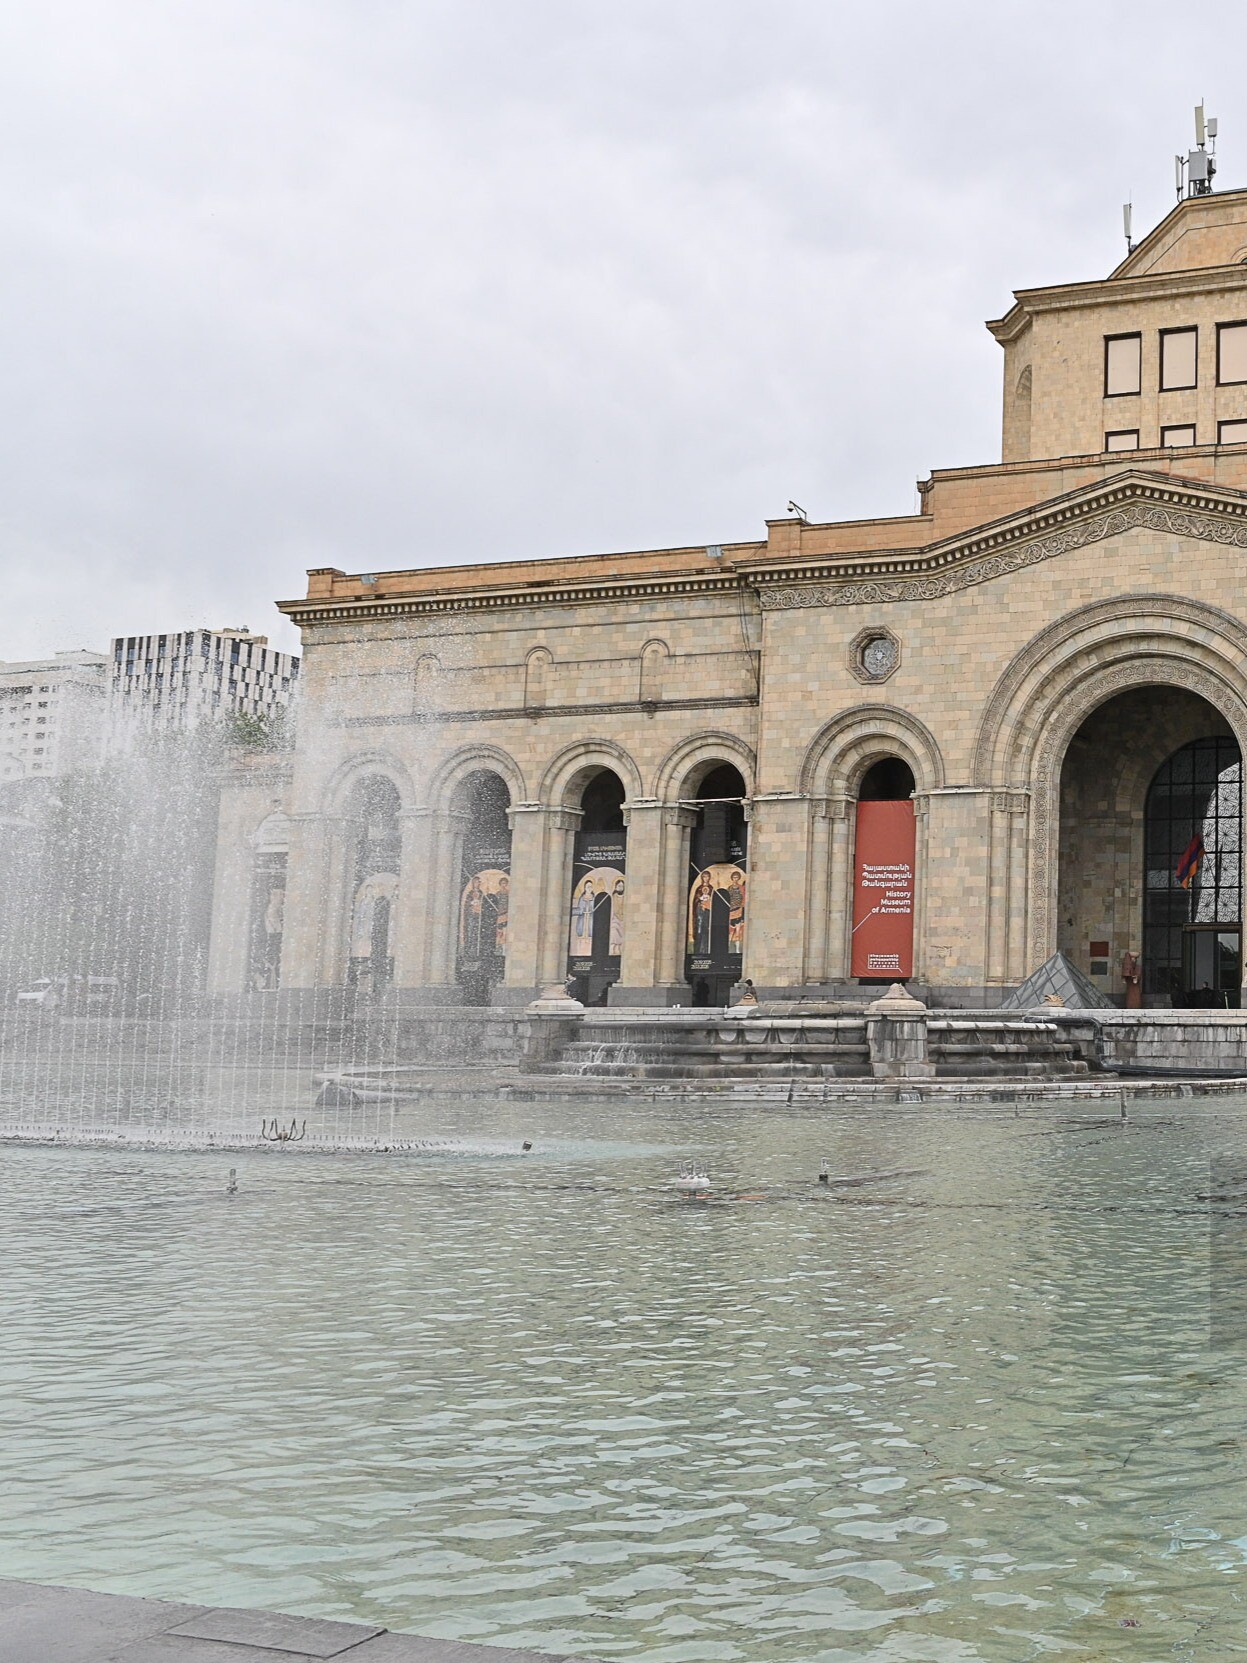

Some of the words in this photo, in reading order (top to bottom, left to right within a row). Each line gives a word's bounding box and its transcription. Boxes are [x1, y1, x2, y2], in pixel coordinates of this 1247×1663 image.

[862, 864, 910, 872] Հայաստանի
[862, 872, 912, 880] Պատմության
[861, 880, 908, 888] Թանգարան
